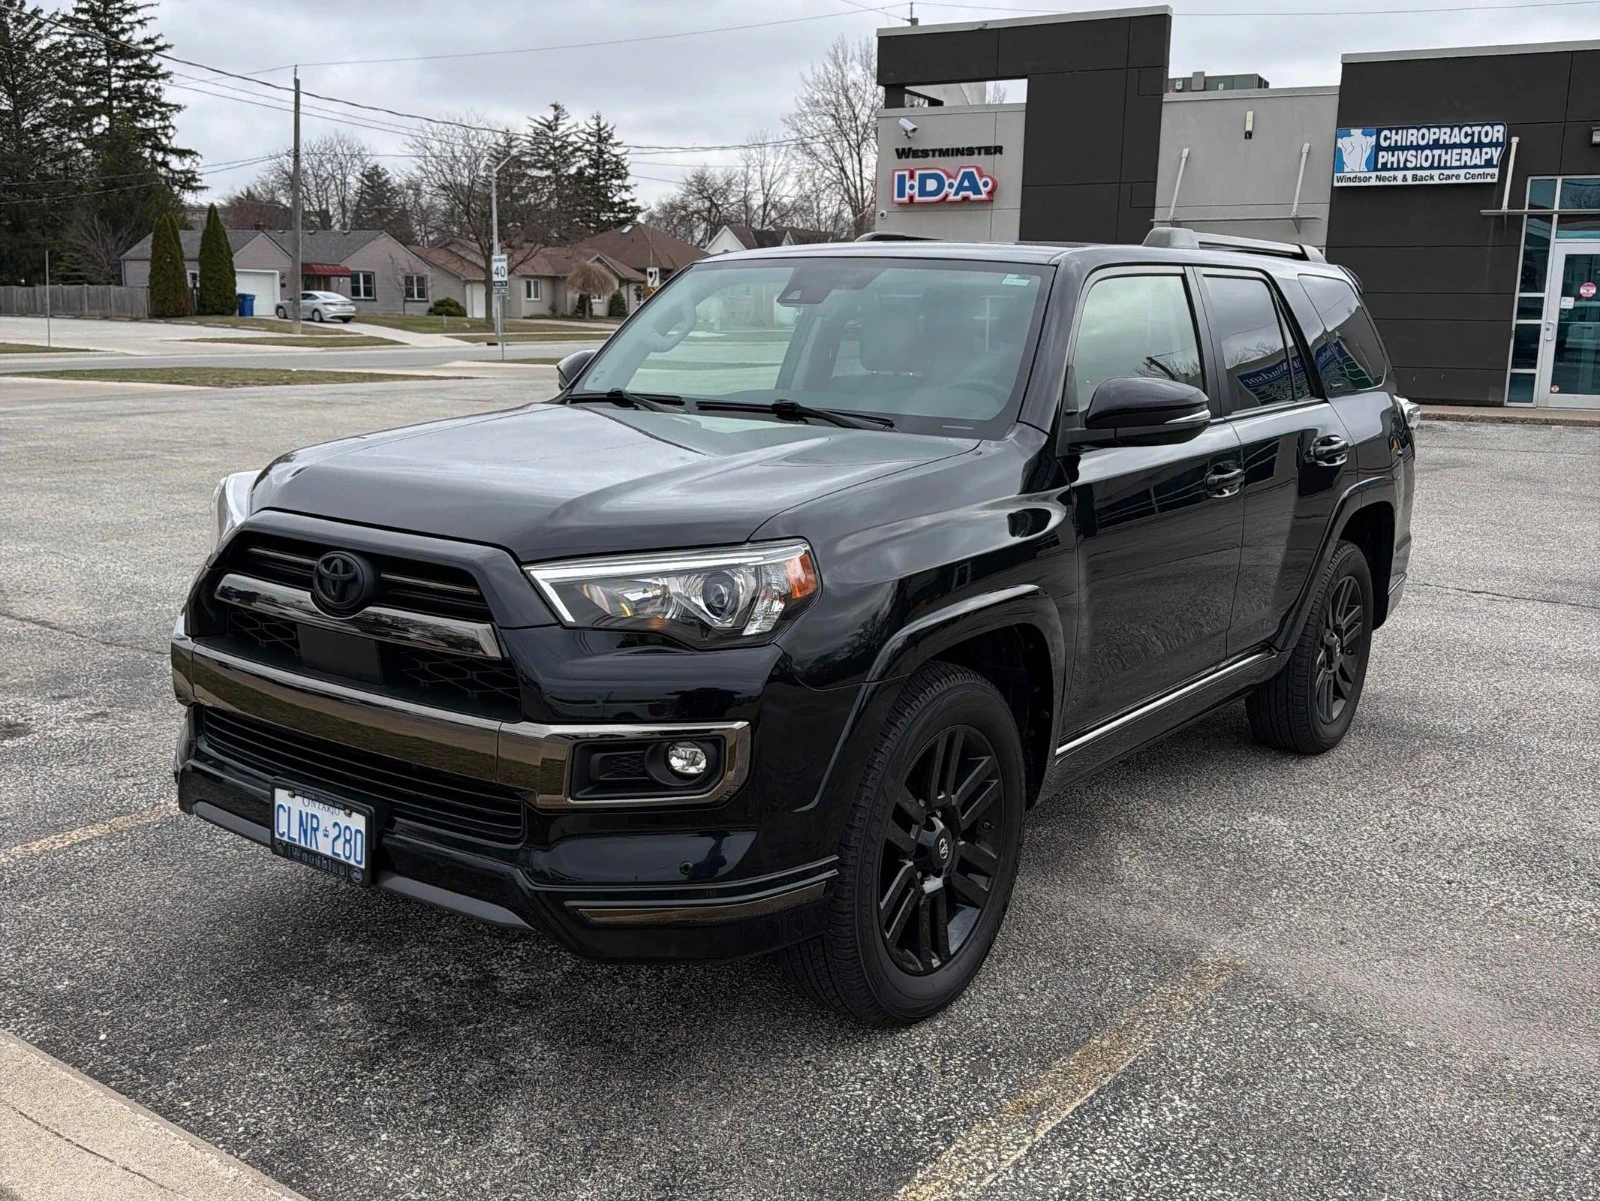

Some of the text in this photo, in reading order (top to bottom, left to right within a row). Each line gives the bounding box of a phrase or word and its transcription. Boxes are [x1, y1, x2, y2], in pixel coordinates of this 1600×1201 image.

[1379, 125, 1504, 147] CHIROPRACTOR
[895, 145, 1003, 159] WESTMINSTER
[1377, 147, 1501, 168] PHYSIOTHERAPY
[1336, 171, 1496, 184] Windsor Neck & Back Care Centre
[494, 266, 506, 278] 40
[276, 803, 364, 866] CLNR 280
